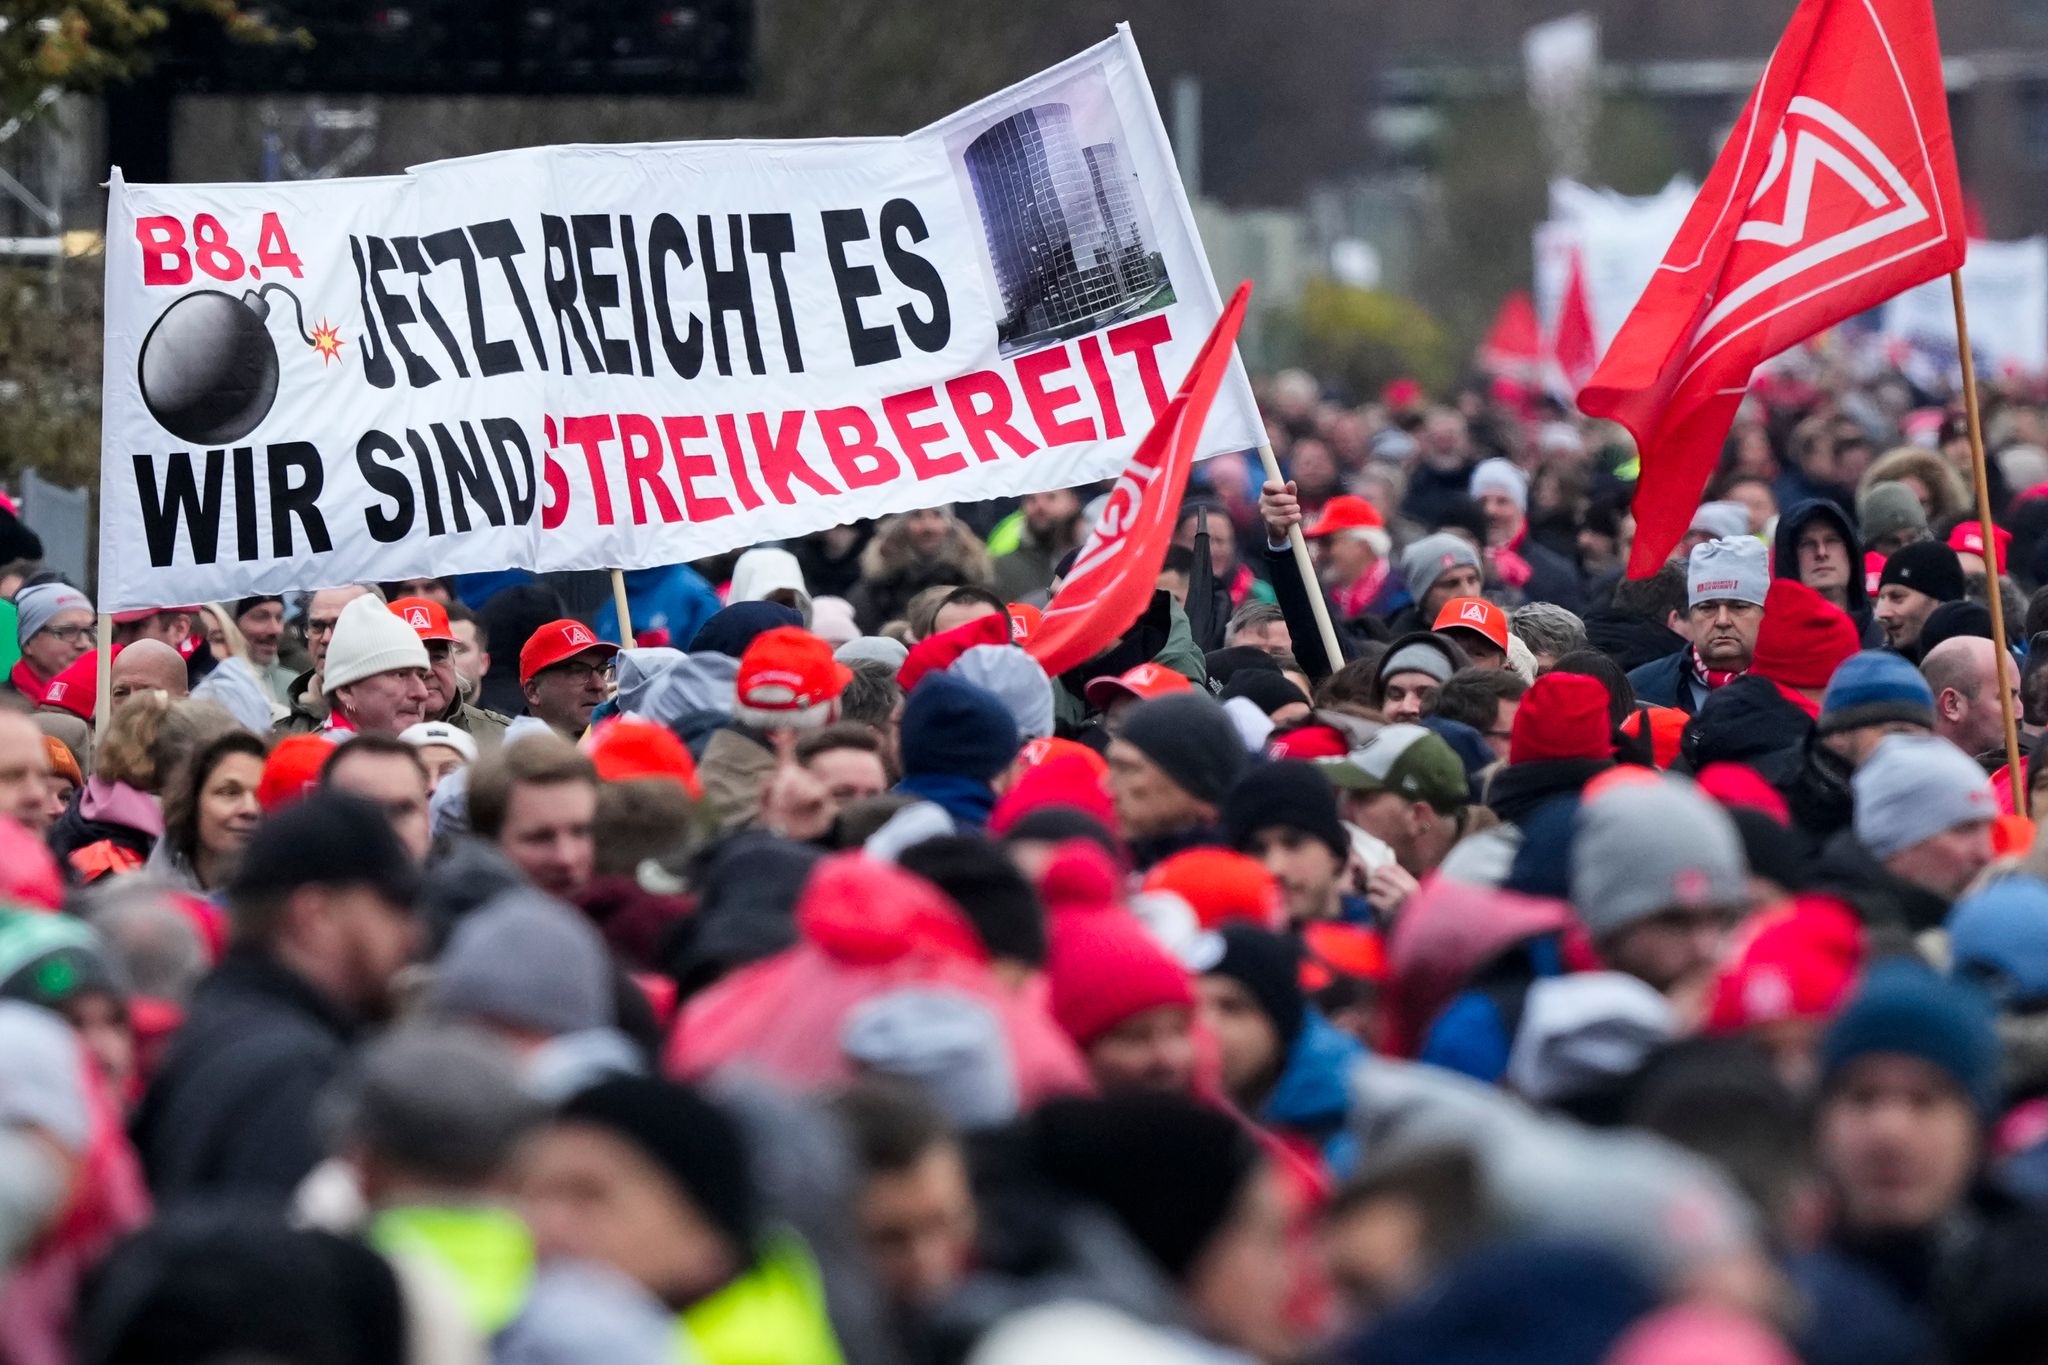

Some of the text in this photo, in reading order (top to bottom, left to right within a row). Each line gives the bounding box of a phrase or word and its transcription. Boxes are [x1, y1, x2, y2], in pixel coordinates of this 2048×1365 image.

[135, 212, 304, 287] B8.4
[349, 198, 951, 389] JETZT REICHT ES
[133, 314, 1173, 568] WIR SIND STREIKBEREIT
